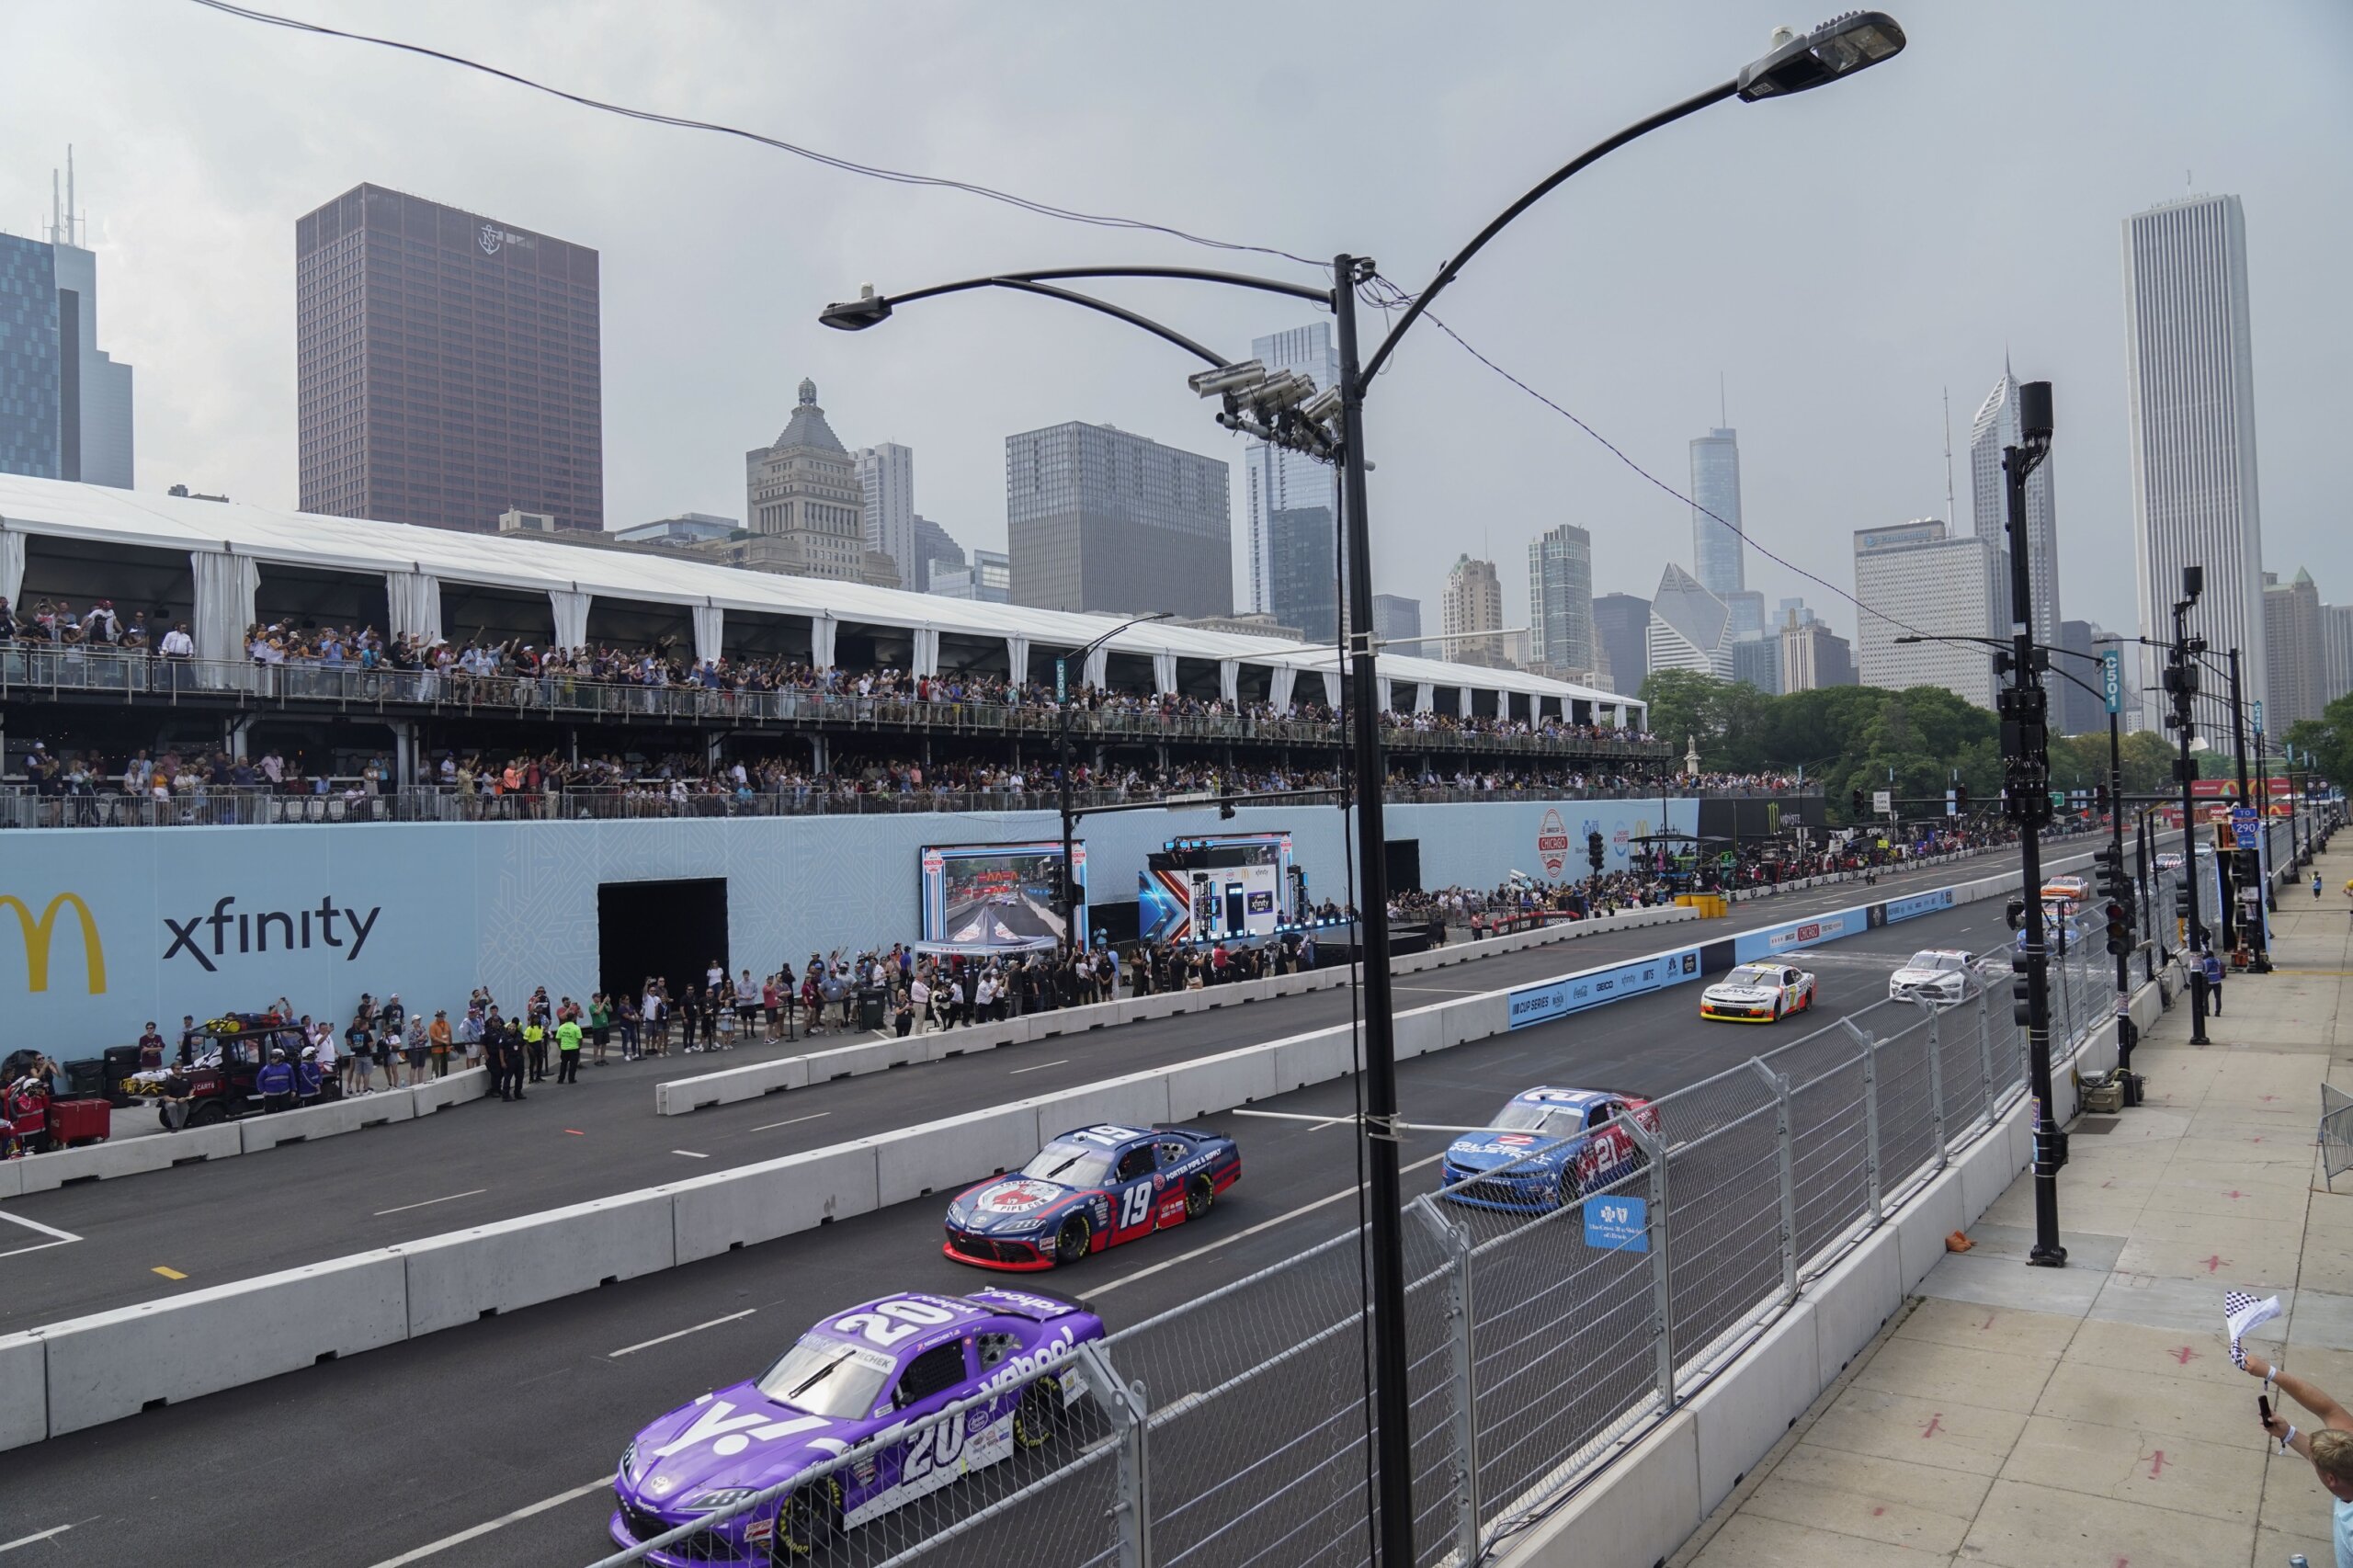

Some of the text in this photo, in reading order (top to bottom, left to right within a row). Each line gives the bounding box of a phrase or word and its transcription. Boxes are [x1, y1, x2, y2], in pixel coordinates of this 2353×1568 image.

[2106, 656, 2118, 707] C501
[1779, 812, 1802, 826] MONSTE
[2236, 824, 2256, 833] 290
[1541, 837, 1566, 850] CHICAGO
[1251, 899, 1269, 910] xfinity
[163, 895, 381, 972] xfinity
[1800, 926, 1818, 940] CHICAGO
[1597, 981, 1614, 992] GEICO
[1519, 996, 1549, 1014] CUP SERIES
[197, 1083, 211, 1091] CART
[1074, 1125, 1141, 1146] 19
[1165, 1165, 1189, 1182] PORTER
[1188, 1158, 1201, 1170] PIPE
[1205, 1147, 1222, 1161] SUPPLY
[1594, 1134, 1619, 1174] 21
[1120, 1180, 1154, 1230] 19
[972, 1285, 1074, 1315] yahoo!
[834, 1301, 956, 1347] 20
[903, 1399, 965, 1484] 20
